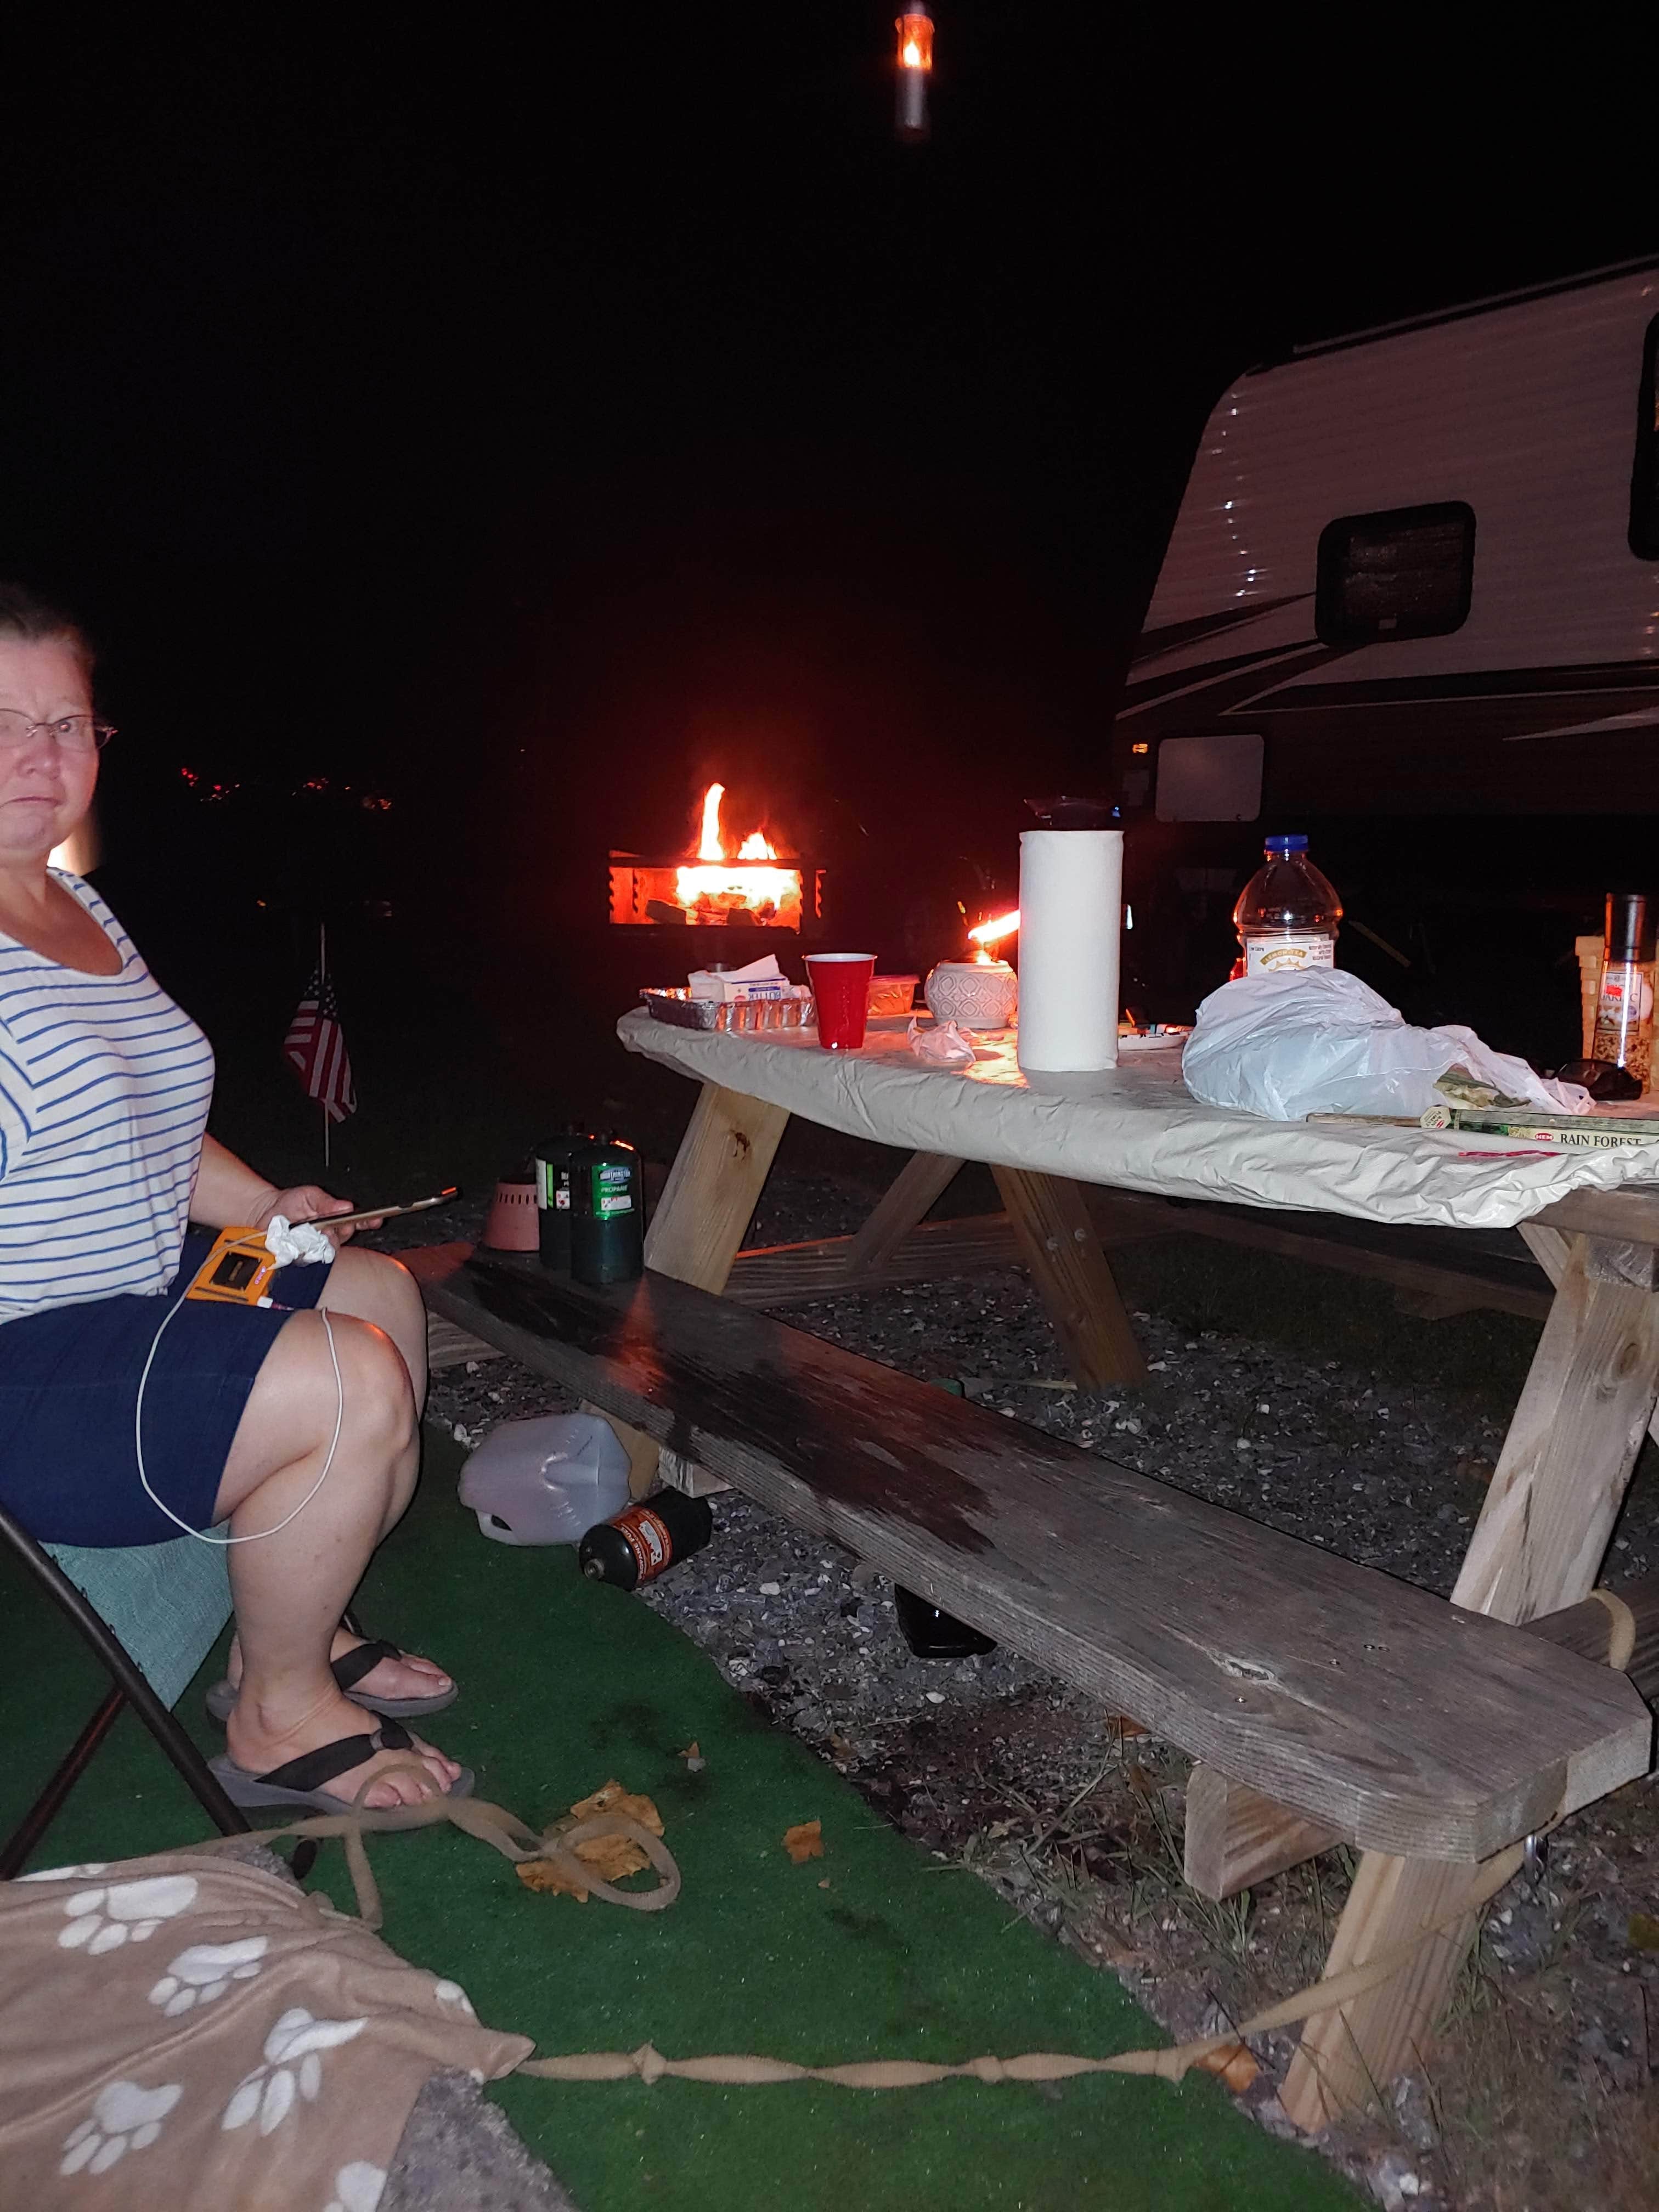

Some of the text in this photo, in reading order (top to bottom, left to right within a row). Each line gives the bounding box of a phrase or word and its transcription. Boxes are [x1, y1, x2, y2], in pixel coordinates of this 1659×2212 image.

[1600, 992, 1638, 1003] GARLC
[1560, 1133, 1590, 1146] RAIN
[1594, 1135, 1642, 1148] FOREST
[601, 1184, 628, 1193] PROPANE
